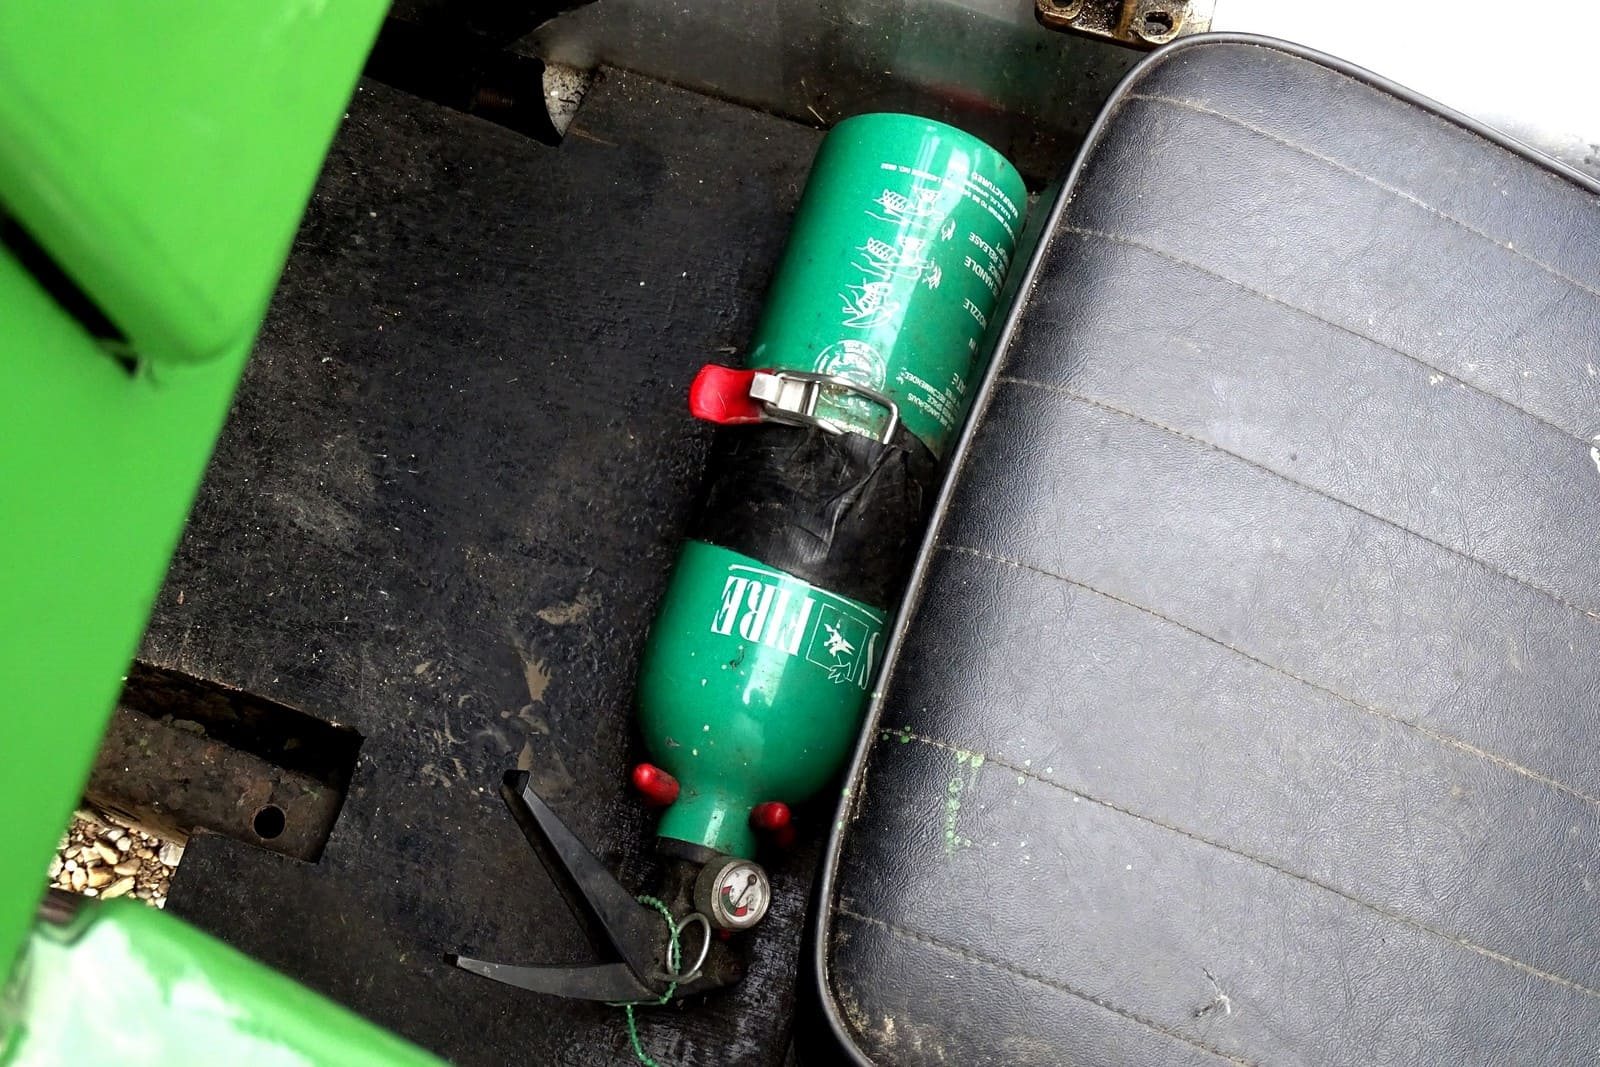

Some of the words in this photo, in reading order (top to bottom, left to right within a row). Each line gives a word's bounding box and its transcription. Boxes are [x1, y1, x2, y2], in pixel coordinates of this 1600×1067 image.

[971, 171, 1019, 219] MANUFACTURED
[968, 231, 999, 263] RELEASE
[963, 255, 994, 289] HANDLE
[963, 297, 988, 330] NOZZLE
[907, 392, 941, 419] DANGEROUS
[710, 575, 817, 657] FIRE
